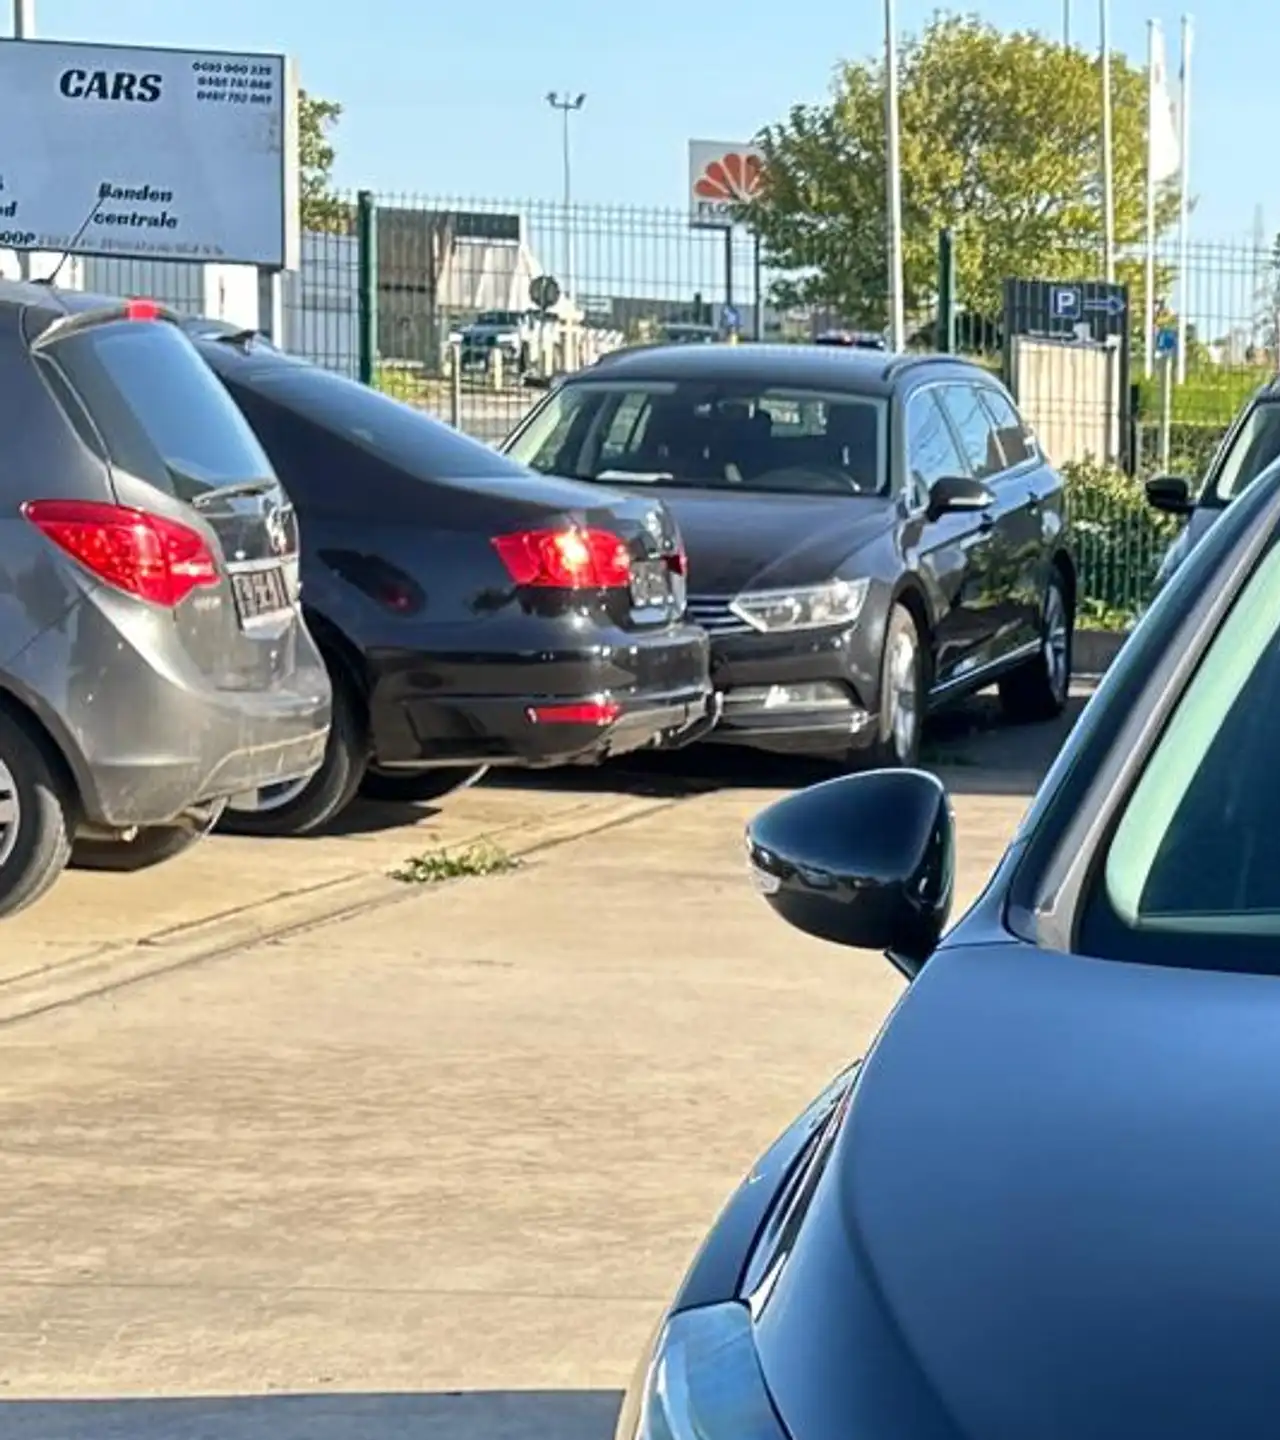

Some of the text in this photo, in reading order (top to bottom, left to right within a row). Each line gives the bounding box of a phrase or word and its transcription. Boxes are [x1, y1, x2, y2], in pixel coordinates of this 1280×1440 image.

[60, 69, 163, 103] CARS
[98, 182, 173, 202] Banden
[93, 211, 178, 229] centrale
[1056, 292, 1076, 315] P
